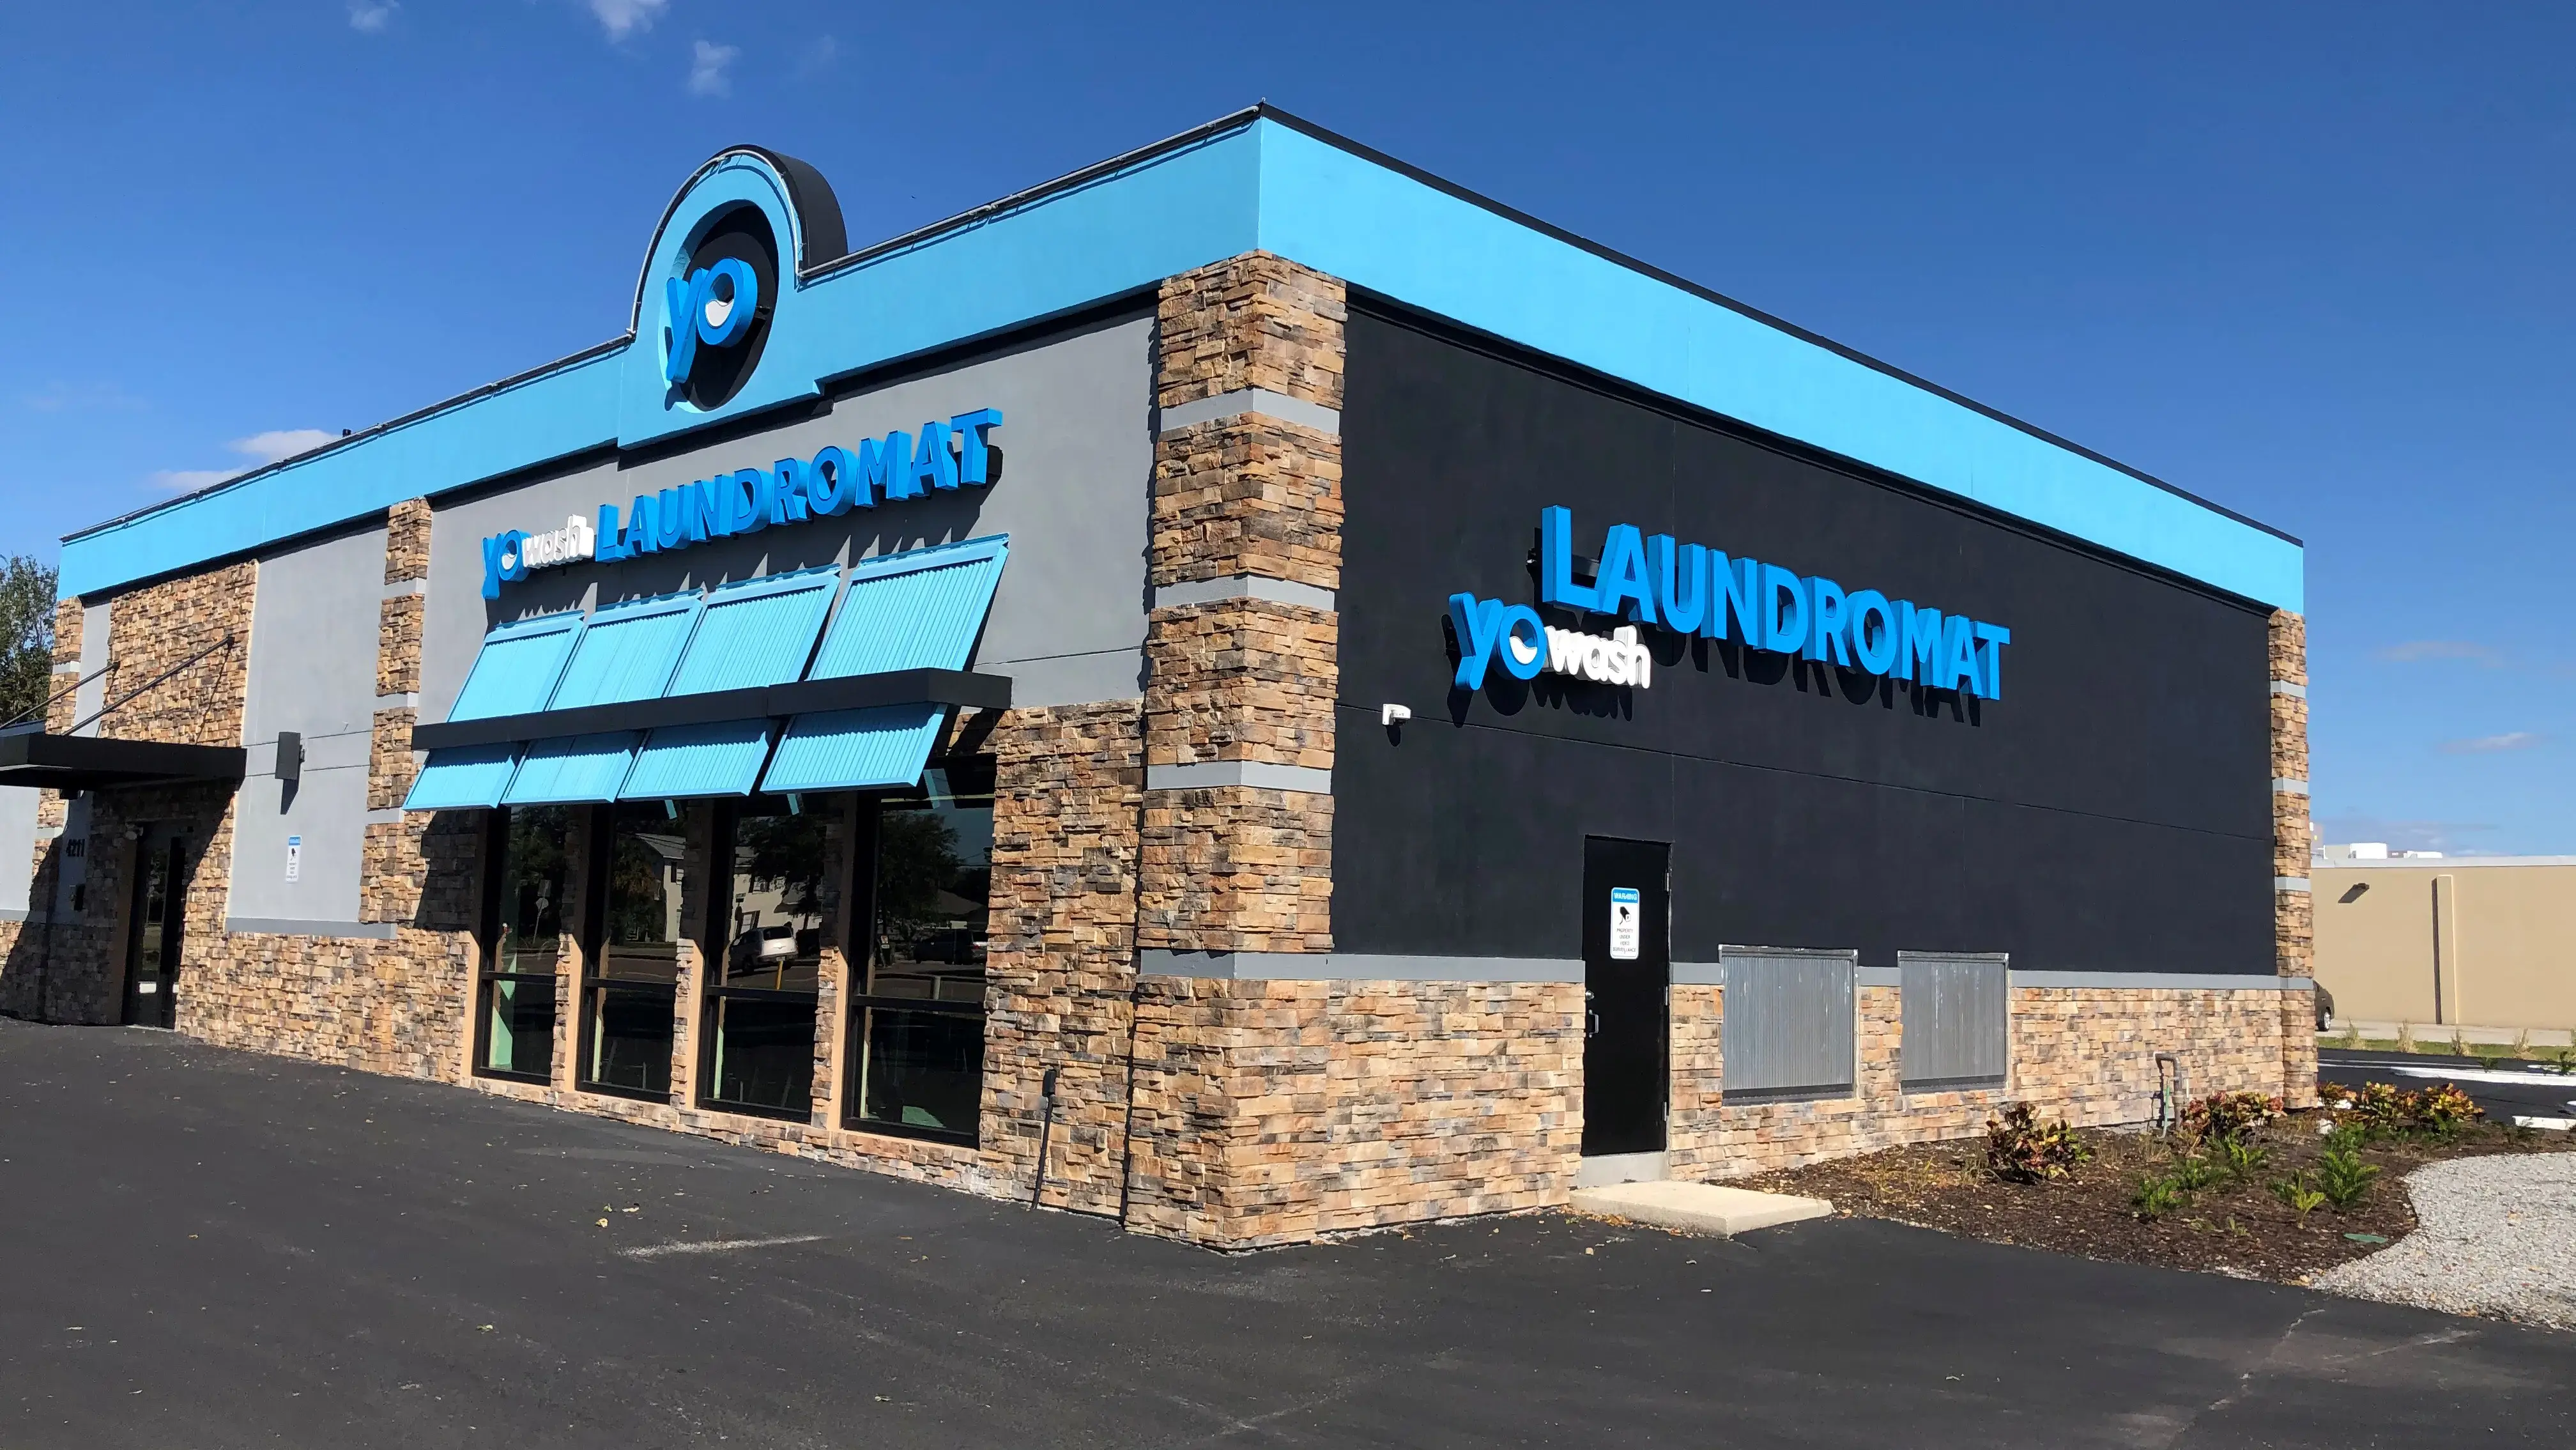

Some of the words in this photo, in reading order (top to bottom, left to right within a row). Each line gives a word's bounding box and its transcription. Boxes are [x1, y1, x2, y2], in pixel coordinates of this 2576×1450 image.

[595, 408, 1002, 563] LAUNDROMAT
[1542, 505, 2010, 700] LAUNDROMAT
[1613, 892, 1637, 900] WARNING
